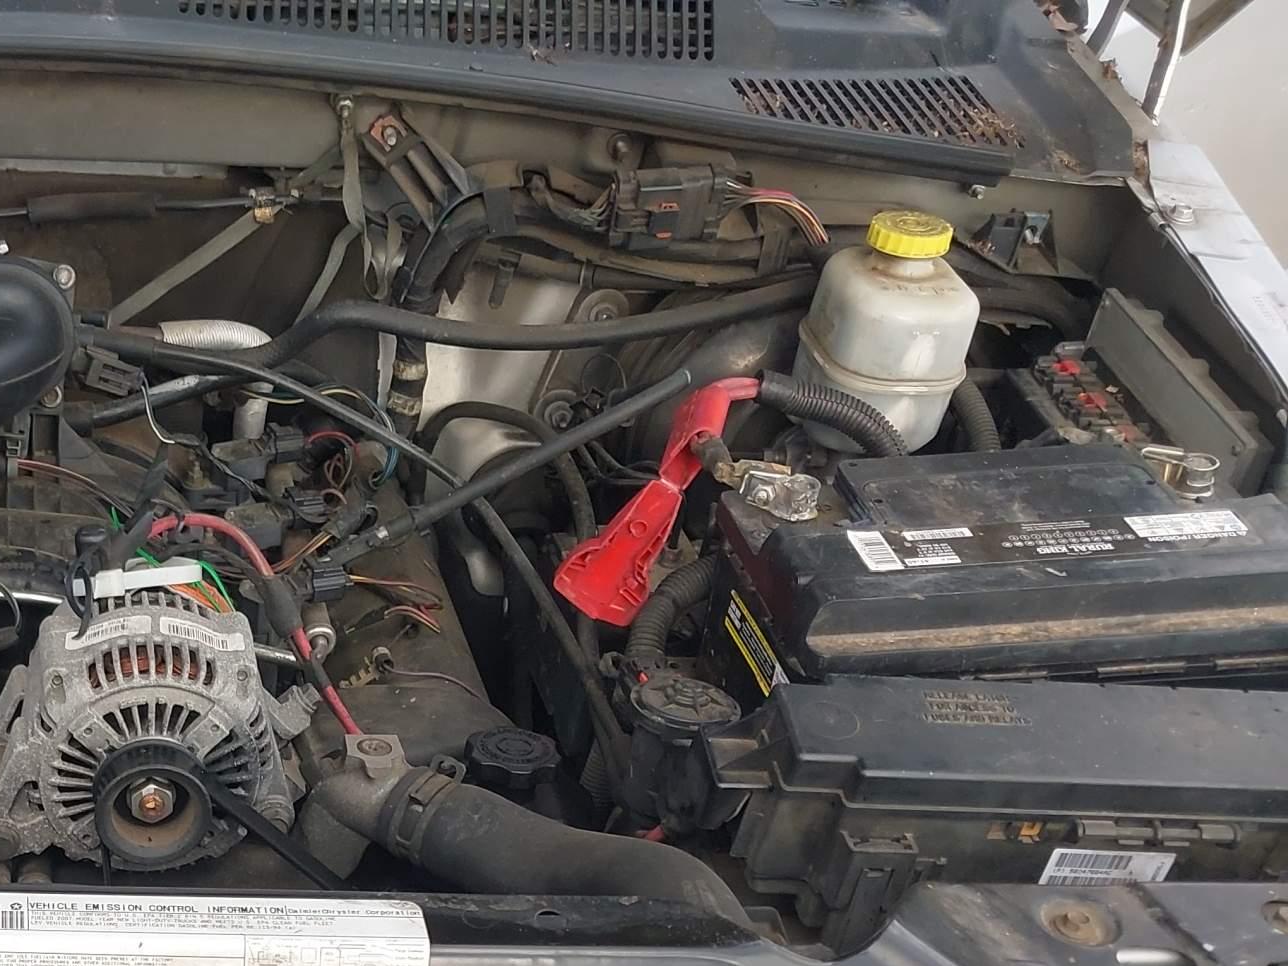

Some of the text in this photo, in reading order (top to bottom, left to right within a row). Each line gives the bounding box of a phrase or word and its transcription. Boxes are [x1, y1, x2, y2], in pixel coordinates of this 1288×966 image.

[1036, 542, 1115, 555] RURAL KING
[29, 903, 284, 914] VEHICLE EMISSION CONTROL INFORMATION
[288, 908, 361, 916] DaimlerChrysler
